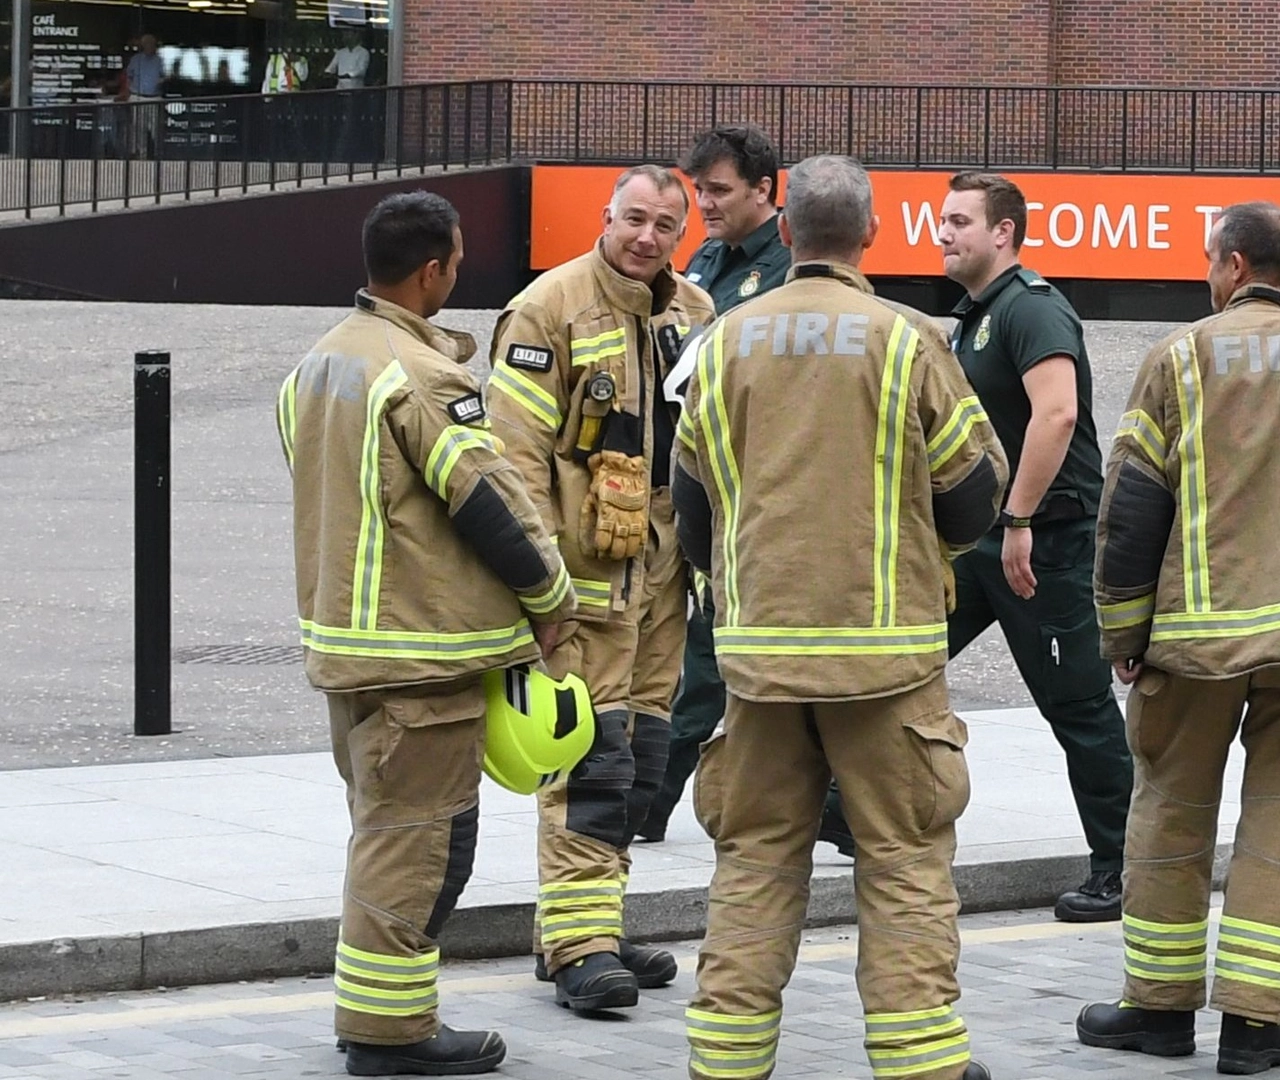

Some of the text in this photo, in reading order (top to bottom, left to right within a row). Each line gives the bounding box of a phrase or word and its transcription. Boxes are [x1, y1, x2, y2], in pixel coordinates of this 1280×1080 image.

[33, 27, 79, 36] ENTRANCE
[157, 45, 249, 85] TATE
[901, 201, 1171, 250] WCOME
[738, 312, 870, 358] FIRE
